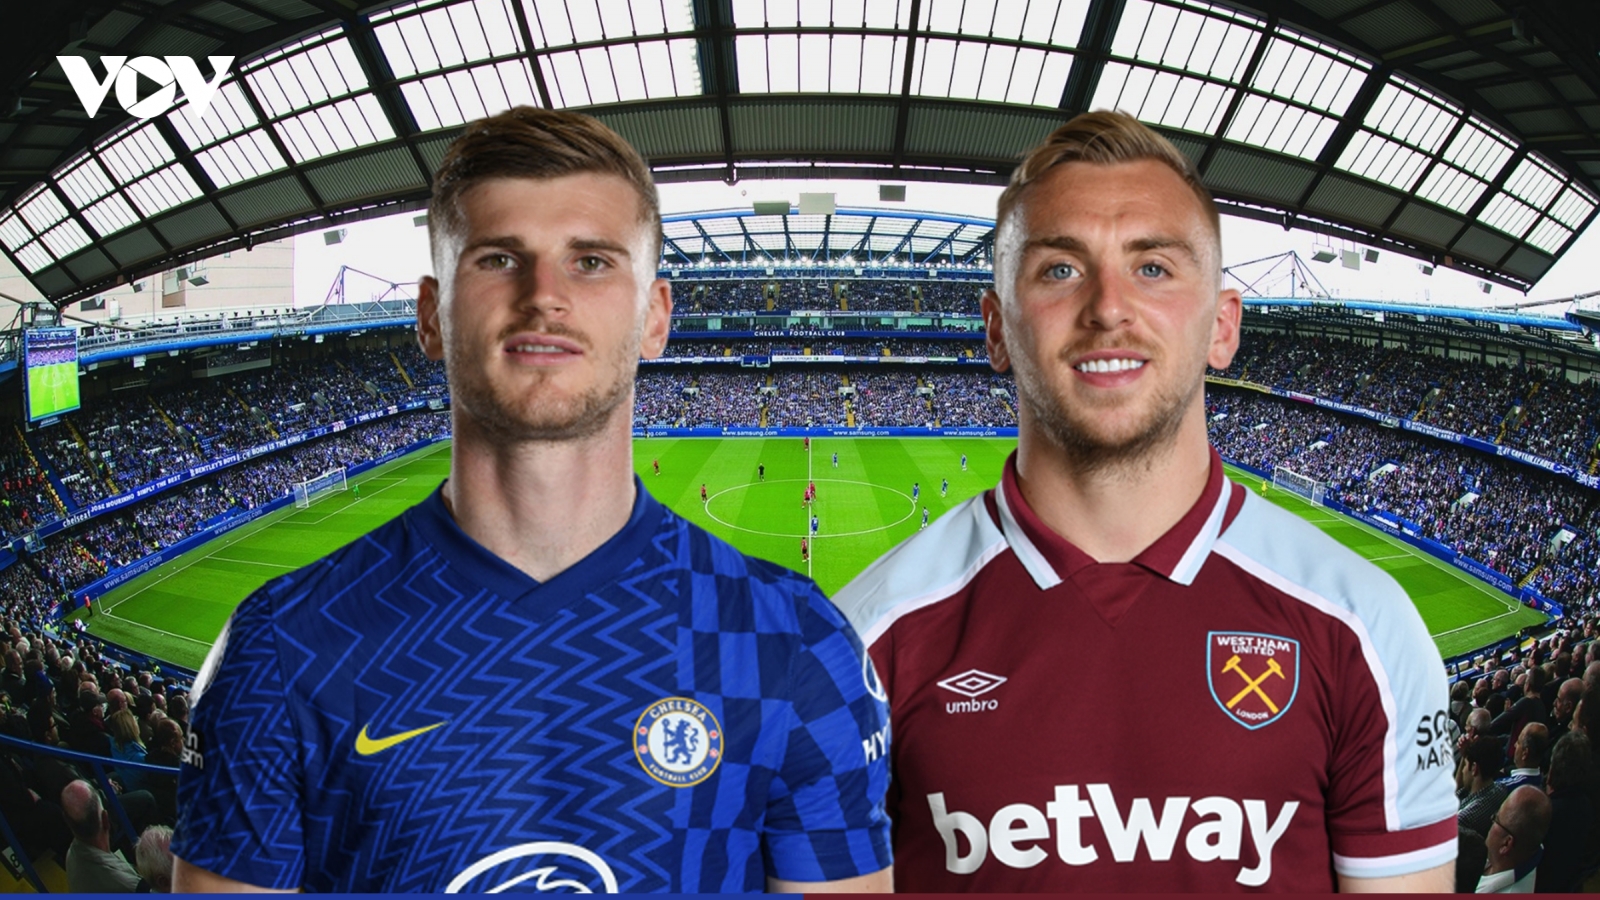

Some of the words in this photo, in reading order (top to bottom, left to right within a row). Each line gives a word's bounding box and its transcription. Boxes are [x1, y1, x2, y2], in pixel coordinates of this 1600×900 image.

[137, 485, 155, 496] SIMPLY
[156, 479, 167, 489] THE
[167, 474, 181, 484] BEST
[214, 508, 263, 536] www.samsung.com
[104, 555, 163, 589] www.samsung.com
[1453, 557, 1513, 593] www.samsung.com
[1216, 636, 1254, 647] WEST
[1256, 638, 1290, 652] HAM
[1231, 645, 1275, 656] UNITED
[649, 701, 707, 721] CHELSEA
[945, 698, 998, 714] umbro
[1235, 708, 1269, 720] LONDON
[649, 764, 686, 782] FOOTBALL
[926, 783, 1300, 887] betway
